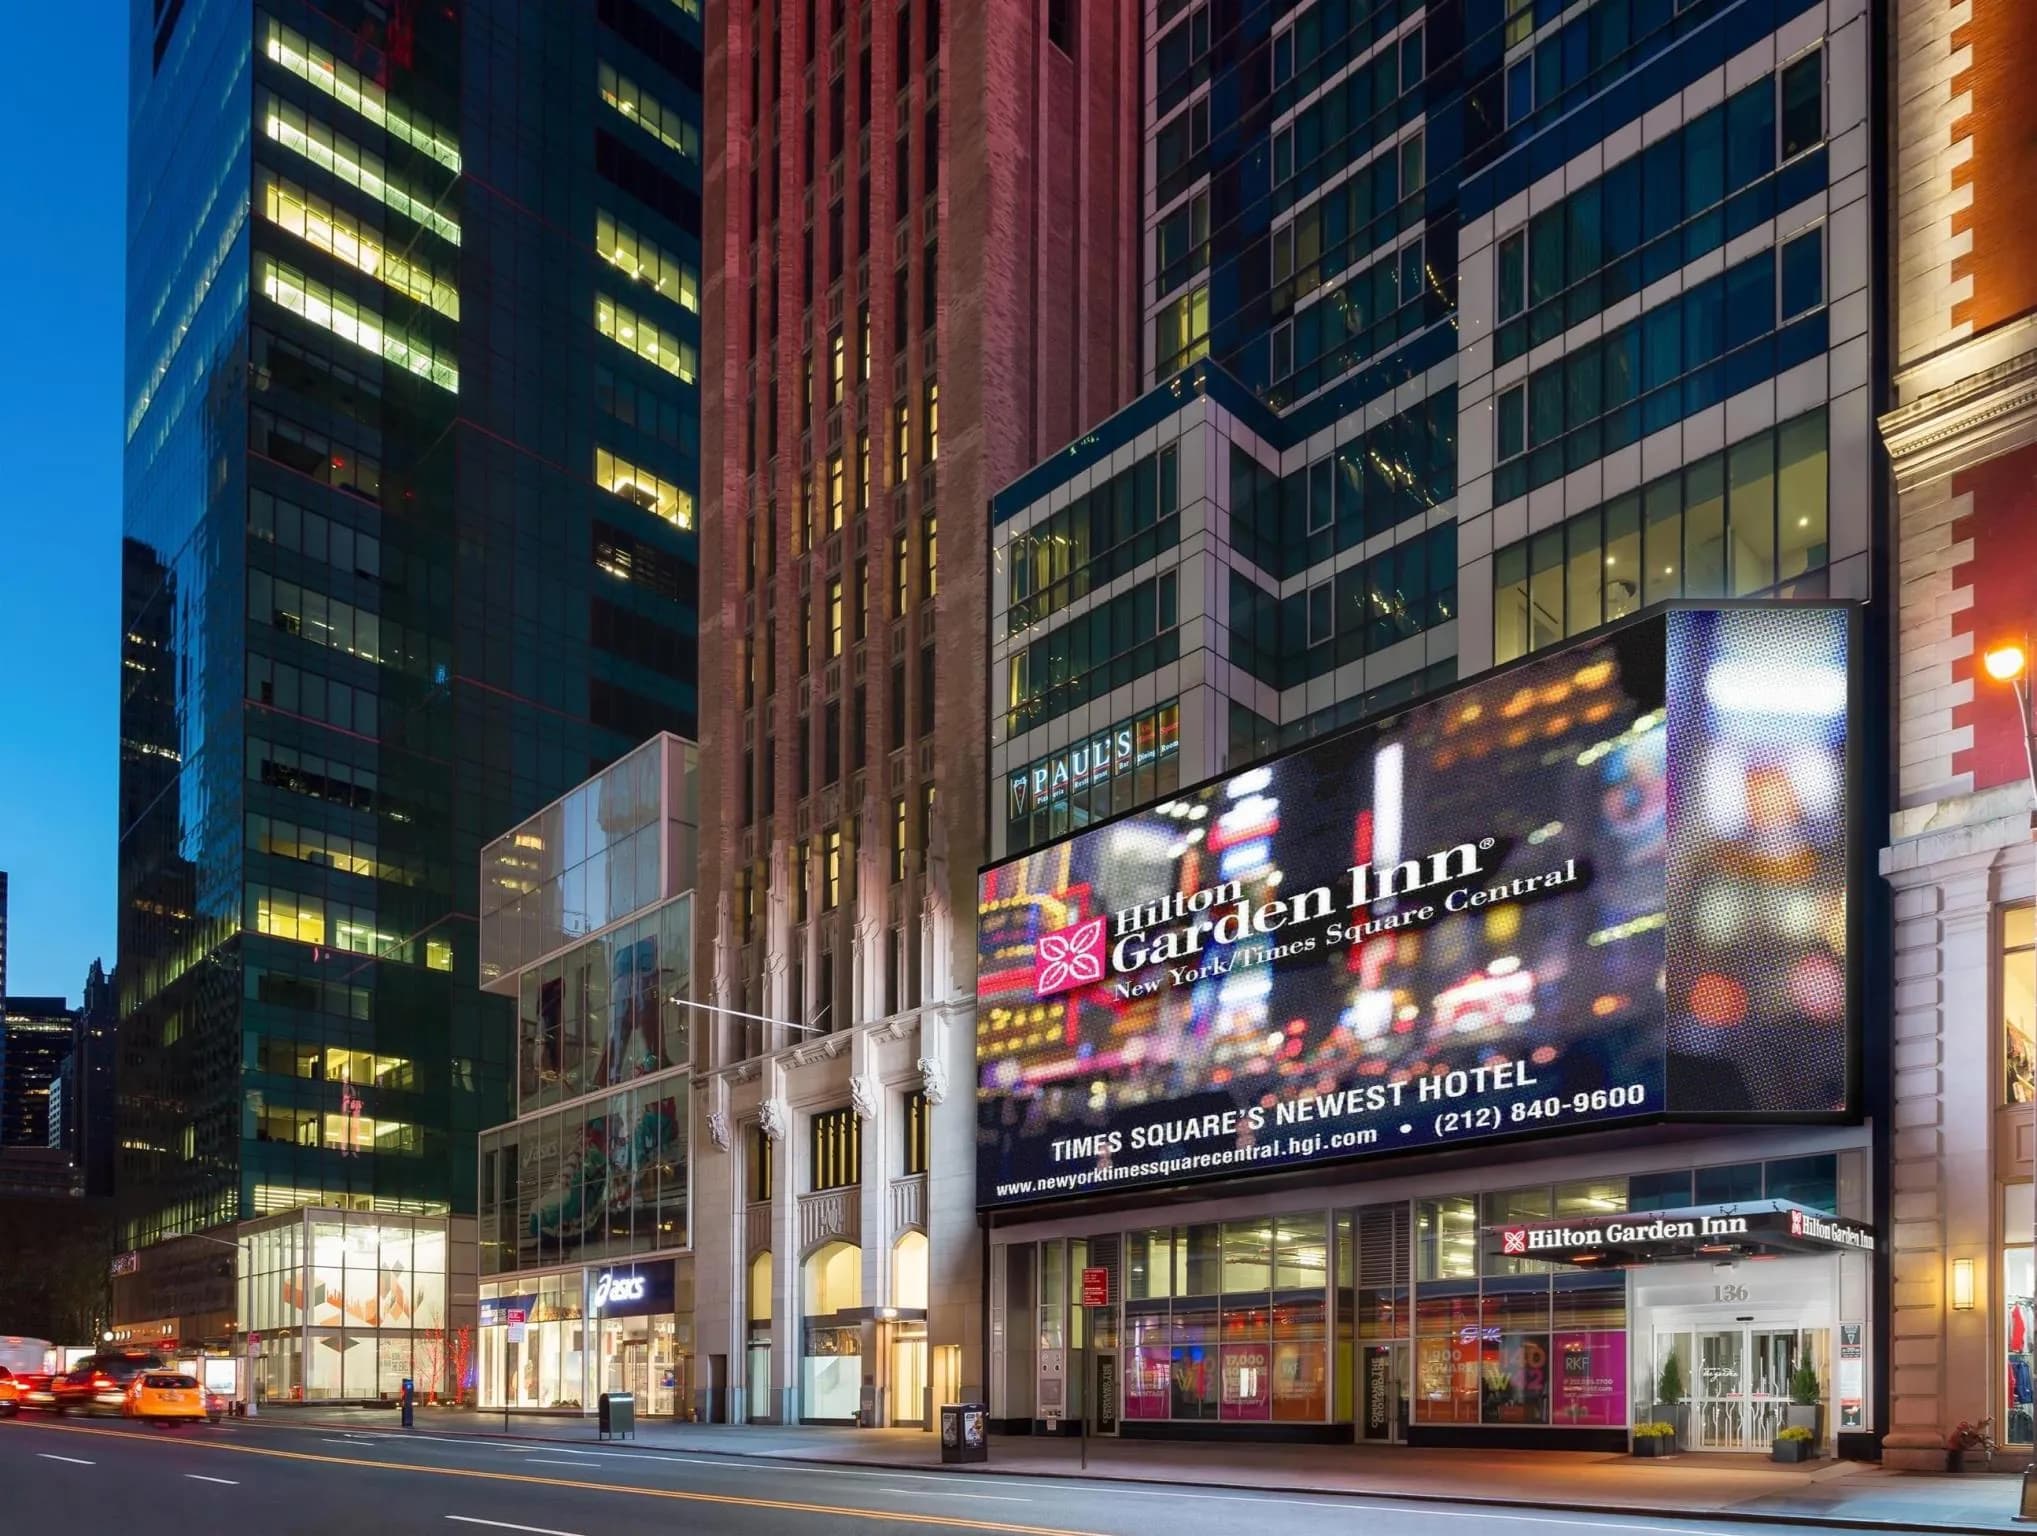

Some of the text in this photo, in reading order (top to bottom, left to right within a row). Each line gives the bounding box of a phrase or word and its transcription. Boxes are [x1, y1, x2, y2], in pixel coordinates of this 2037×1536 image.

[1034, 731, 1130, 793] PAUL'S
[1112, 884, 1336, 972] Garden
[1114, 880, 1244, 937] Hilton
[1114, 978, 1161, 1002] New
[1326, 903, 1434, 945] Square
[1445, 858, 1577, 912] Central
[996, 1084, 1645, 1197] www.newyorktimessquarecentral.hgi.com (212) 840-9600
[1052, 1060, 1537, 1162] TIMES SQUARE'S NEWEST HOTEL
[1527, 1215, 1748, 1248] Hilton Garden Inn
[1802, 1215, 1875, 1250] Hilton Garden Inn
[1713, 1283, 1749, 1302] 136
[1566, 1357, 1589, 1370] RKF
